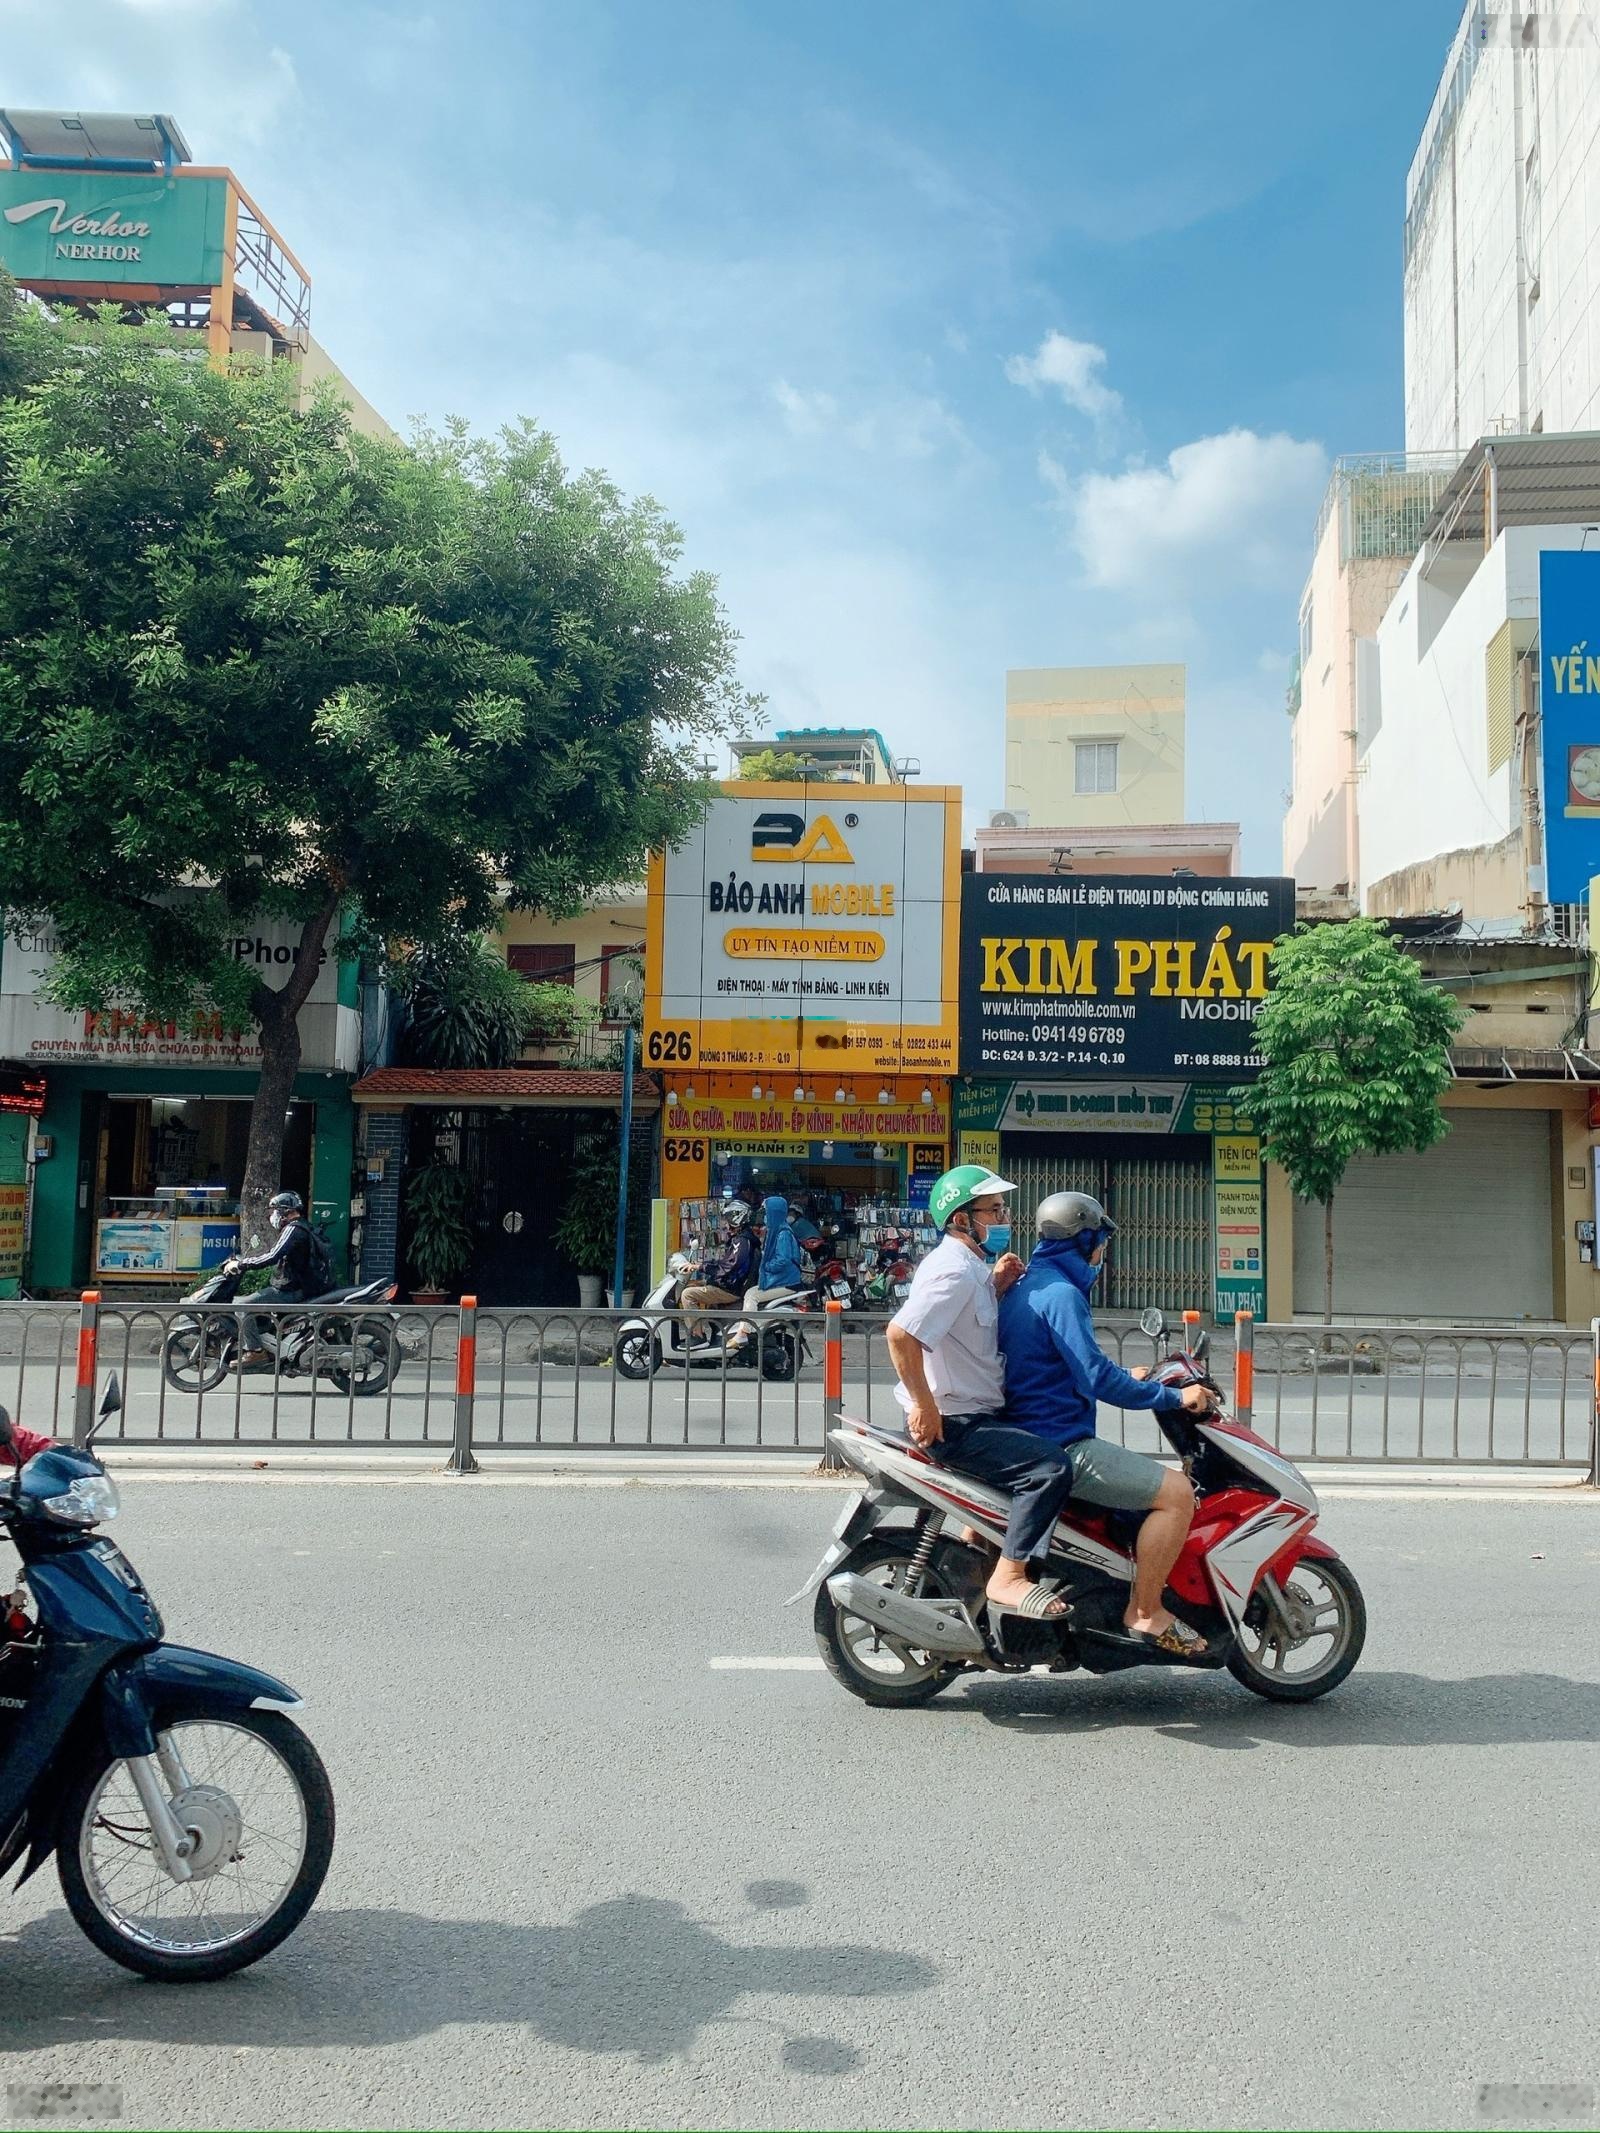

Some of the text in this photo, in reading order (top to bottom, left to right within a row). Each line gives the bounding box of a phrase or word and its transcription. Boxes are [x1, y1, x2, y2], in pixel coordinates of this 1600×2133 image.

[4, 199, 150, 237] Verhor
[55, 242, 141, 262] NERHOR
[1551, 640, 1600, 693] YẾN
[710, 871, 895, 916] BẢO ANH MOBILE
[987, 882, 1269, 908] CỬA HÀNG BÁN LẺ ĐIỆN THOẠI DI ĐỘNG CHÍNH HÃNG
[732, 934, 877, 955] UY TÍN TẠO NIỀM TIN
[980, 925, 1276, 998] KIM PHÁT
[717, 977, 890, 998] ĐIỆN THOẠI MÁY TÍNH BẢNG LINH KIỆN
[982, 998, 1136, 1021] www.kimphatmobile.com.vn
[855, 1037, 867, 1048] 557
[907, 1038, 925, 1050] 02822
[928, 1039, 939, 1050] 433
[982, 1028, 1029, 1042] Hotline:
[31, 1039, 77, 1052] CHUYÊN
[159, 1041, 190, 1055] CHỮA
[648, 1030, 692, 1062] 626
[721, 1051, 726, 1062] 3
[727, 1046, 747, 1063] THÁNG
[749, 1052, 754, 1063] 2
[982, 1049, 1001, 1061] ĐC:
[1003, 1050, 1024, 1061] 624
[1174, 1053, 1268, 1066] ĐT: 08 8888 1119
[960, 1087, 978, 1102] TIỆN
[668, 1104, 945, 1140] SỬA CHỮA MUA BÁN ÉP KÍNH NHẬN CHUYỂN TIỀN
[665, 1139, 705, 1162] 626
[790, 1145, 805, 1155] 12
[915, 1150, 942, 1163] CN2
[963, 1140, 997, 1157] TIỆN ÍCH
[1217, 1145, 1258, 1163] TIỆN ÍCH
[936, 1187, 961, 1211] Grab
[1217, 1193, 1239, 1201] THANH
[1217, 1285, 1263, 1314] KIM PHÁT
